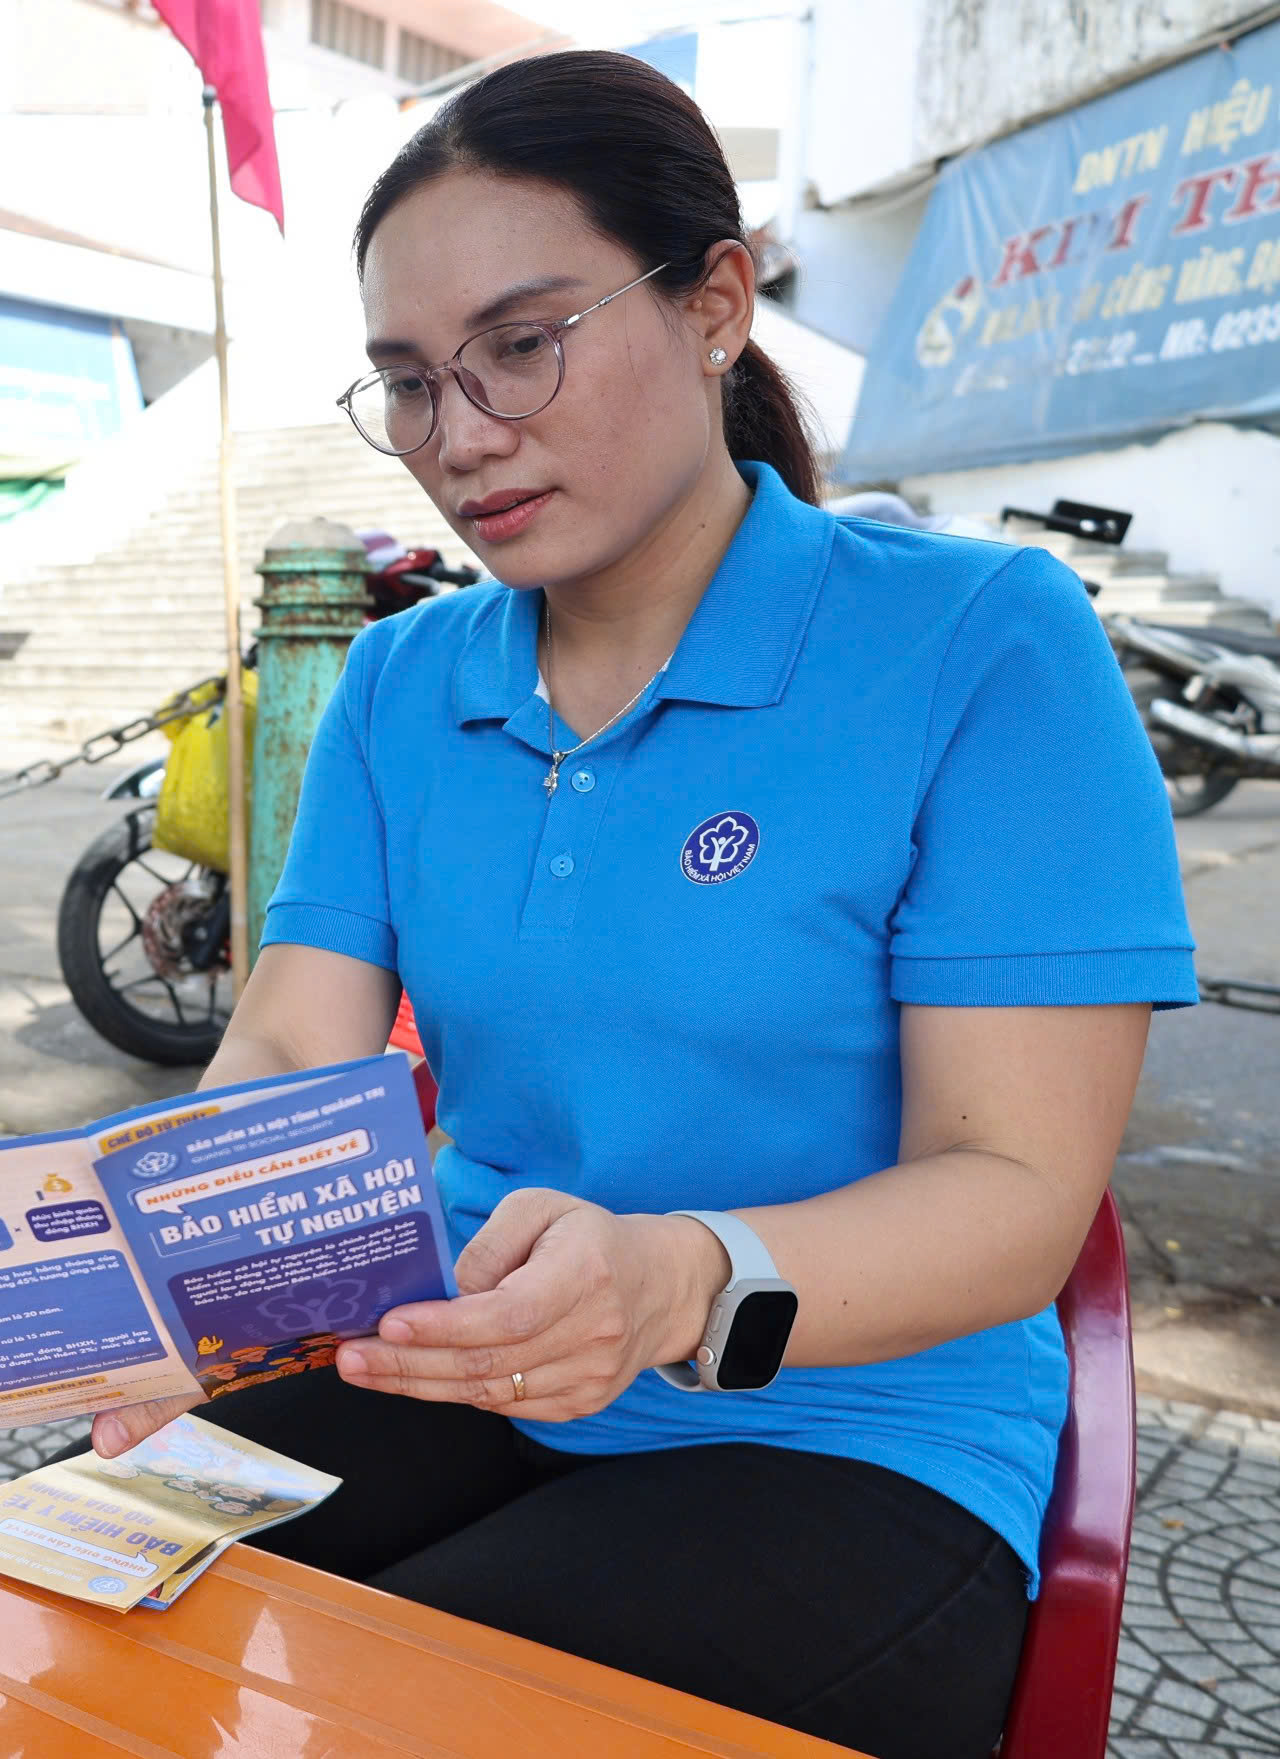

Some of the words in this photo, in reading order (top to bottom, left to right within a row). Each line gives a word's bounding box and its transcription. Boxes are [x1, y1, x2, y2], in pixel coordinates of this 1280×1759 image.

[698, 874, 710, 882] XÃ
[711, 873, 726, 883] HỘI
[727, 862, 744, 877] VIỆT
[741, 843, 756, 863] NAM
[108, 1132, 130, 1148] CHẾ
[187, 1138, 212, 1153] BẢO
[247, 1122, 265, 1136] XÃ
[145, 1182, 209, 1205] NHỮNG
[214, 1168, 253, 1186] ĐIỀU
[259, 1156, 297, 1174] CẦN
[298, 1146, 332, 1163] BIẾT
[338, 1138, 359, 1151] VỀ
[159, 1213, 223, 1246] BẢO
[229, 1190, 308, 1228] HIỂM
[314, 1173, 357, 1205] XÃ
[364, 1157, 415, 1192] HỘI
[256, 1219, 296, 1247] TỰ
[302, 1185, 421, 1235] NGUYỆN
[13, 1268, 32, 1279] hưu
[36, 1262, 62, 1275] hằng
[65, 1256, 94, 1270] tháng
[98, 1253, 116, 1263] của
[17, 1276, 38, 1286] 45%
[40, 1270, 68, 1283] tương
[70, 1266, 90, 1277] ứng
[91, 1263, 106, 1272] với
[108, 1261, 119, 1269] số
[13, 1312, 23, 1321] là
[23, 1310, 37, 1319] 20
[39, 1306, 63, 1316] năm.
[1, 1337, 13, 1345] nữ
[15, 1335, 25, 1343] là
[27, 1333, 37, 1341] 15
[39, 1328, 63, 1338] năm.
[1, 1494, 33, 1512] TẾ
[36, 1504, 55, 1517] Y
[56, 1510, 126, 1539] HIỂM
[127, 1532, 183, 1556] BẢO
